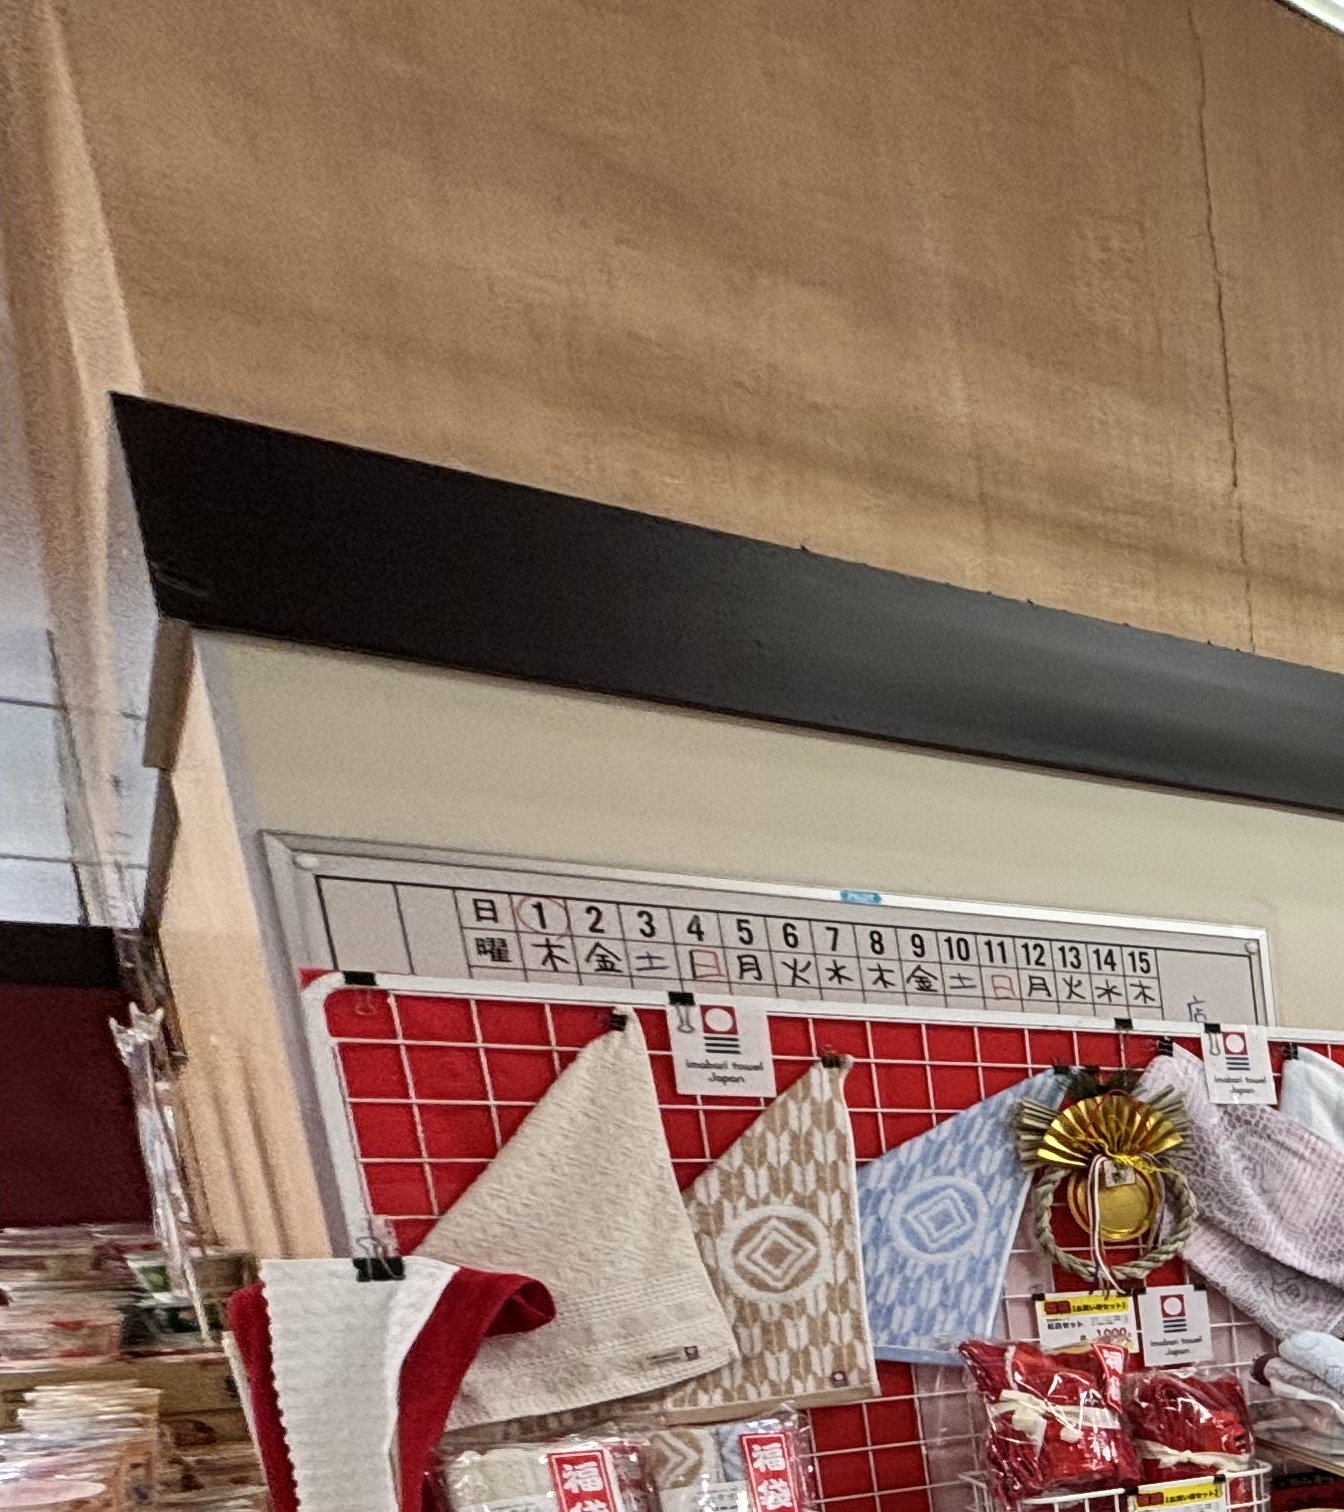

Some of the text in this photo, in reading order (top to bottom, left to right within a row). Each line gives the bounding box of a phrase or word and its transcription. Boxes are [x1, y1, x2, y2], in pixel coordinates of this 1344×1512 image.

[474, 899, 1152, 974] 日 1 2 3 4 5 6 7 8 9 10 11 12 13 14 15
[475, 937, 511, 963] 曜
[532, 938, 572, 971] 木
[585, 942, 624, 974] 金
[636, 952, 669, 973] 土
[737, 954, 764, 982] 月
[783, 957, 812, 986] 火
[826, 960, 855, 986] 水
[868, 963, 897, 990] 木
[907, 964, 939, 994] 金
[950, 972, 977, 990] 土
[990, 973, 1019, 1000] 日
[1027, 972, 1054, 998] 月
[1063, 975, 1088, 1001] 火
[1095, 978, 1122, 1002] 水
[1127, 980, 1156, 1004] 木
[751, 1443, 794, 1511] 福袋
